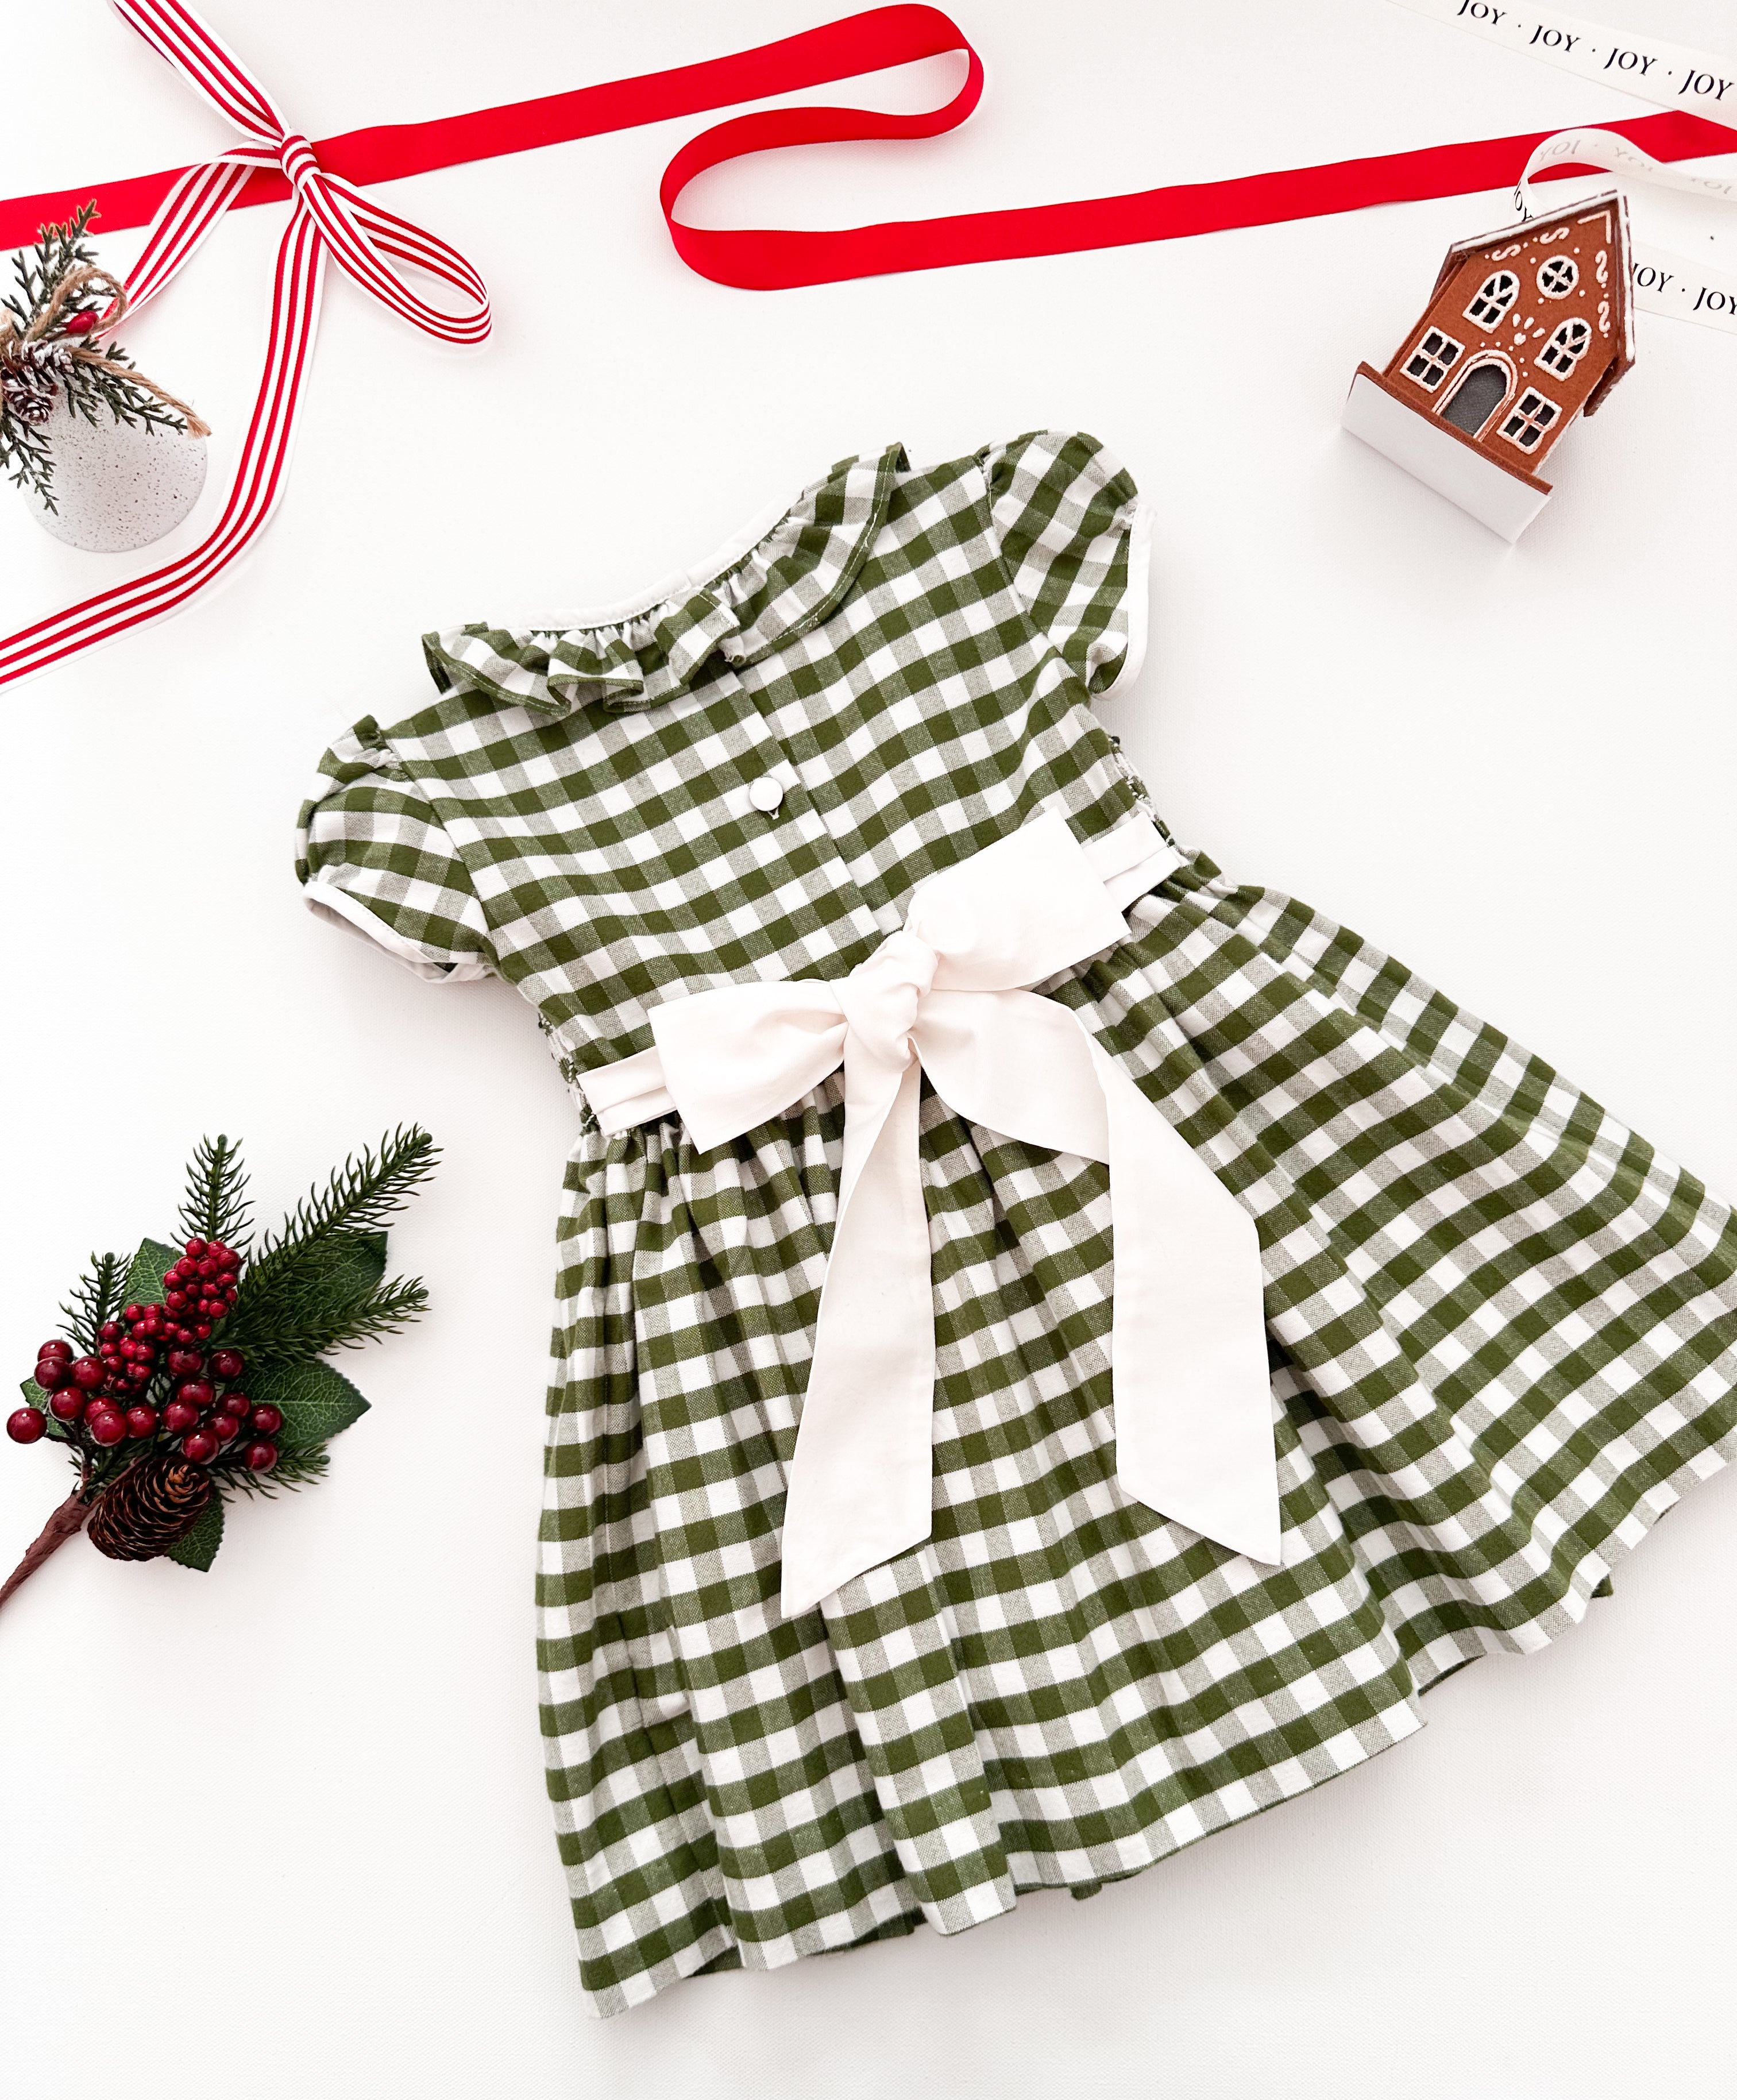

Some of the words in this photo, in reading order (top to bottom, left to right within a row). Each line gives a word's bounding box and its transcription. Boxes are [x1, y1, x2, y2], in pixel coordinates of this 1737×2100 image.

[1457, 0, 1507, 25] JOY
[1529, 25, 1581, 52] JOY
[1603, 48, 1658, 76] JOY
[1678, 69, 1735, 101] JOY
[1693, 287, 1737, 315] JOY
